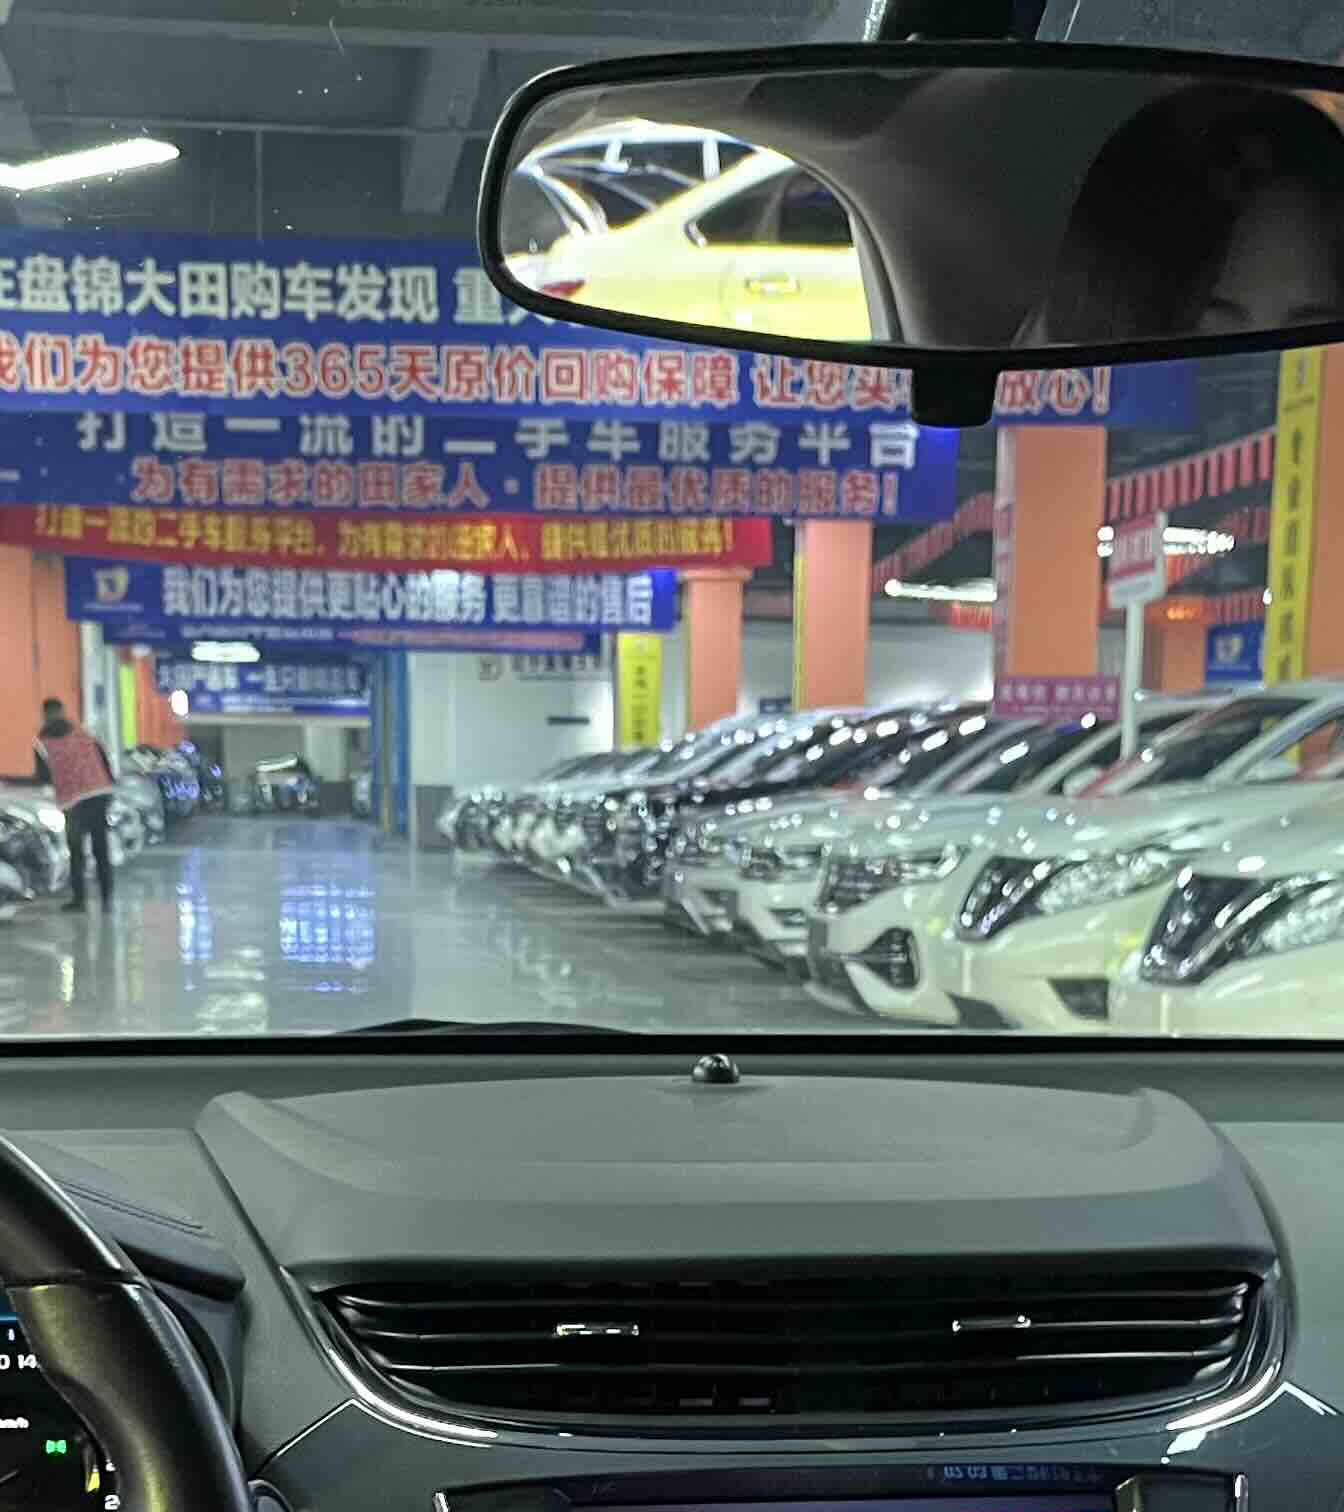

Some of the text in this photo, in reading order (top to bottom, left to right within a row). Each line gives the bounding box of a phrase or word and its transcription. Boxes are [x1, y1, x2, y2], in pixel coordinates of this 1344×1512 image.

[751, 354, 1111, 415] 让您买放心!
[17, 1354, 42, 1370] 14
